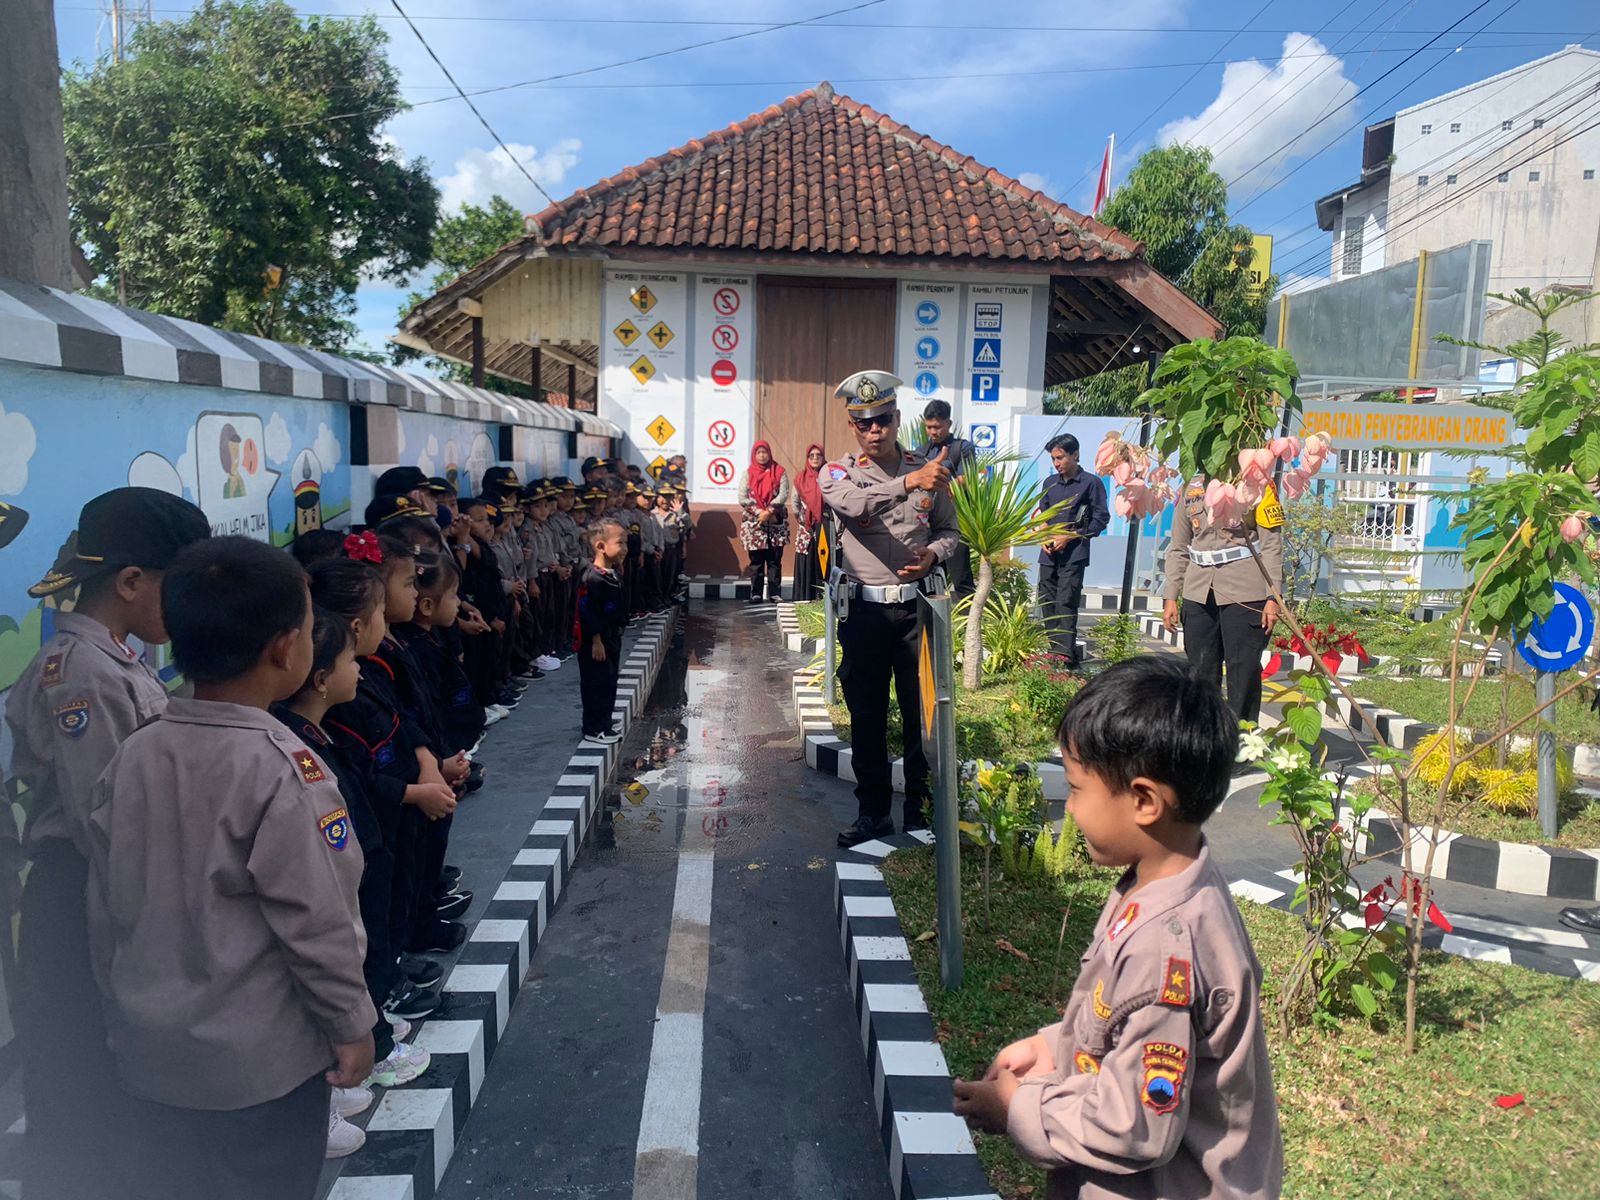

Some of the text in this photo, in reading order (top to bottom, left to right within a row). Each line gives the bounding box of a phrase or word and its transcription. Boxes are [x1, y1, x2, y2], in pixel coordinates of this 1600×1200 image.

[979, 376, 993, 400] P
[1298, 411, 1507, 444] JEMBATAN PENYEBRANGAN ORANG
[1146, 1043, 1184, 1058] POLDA
